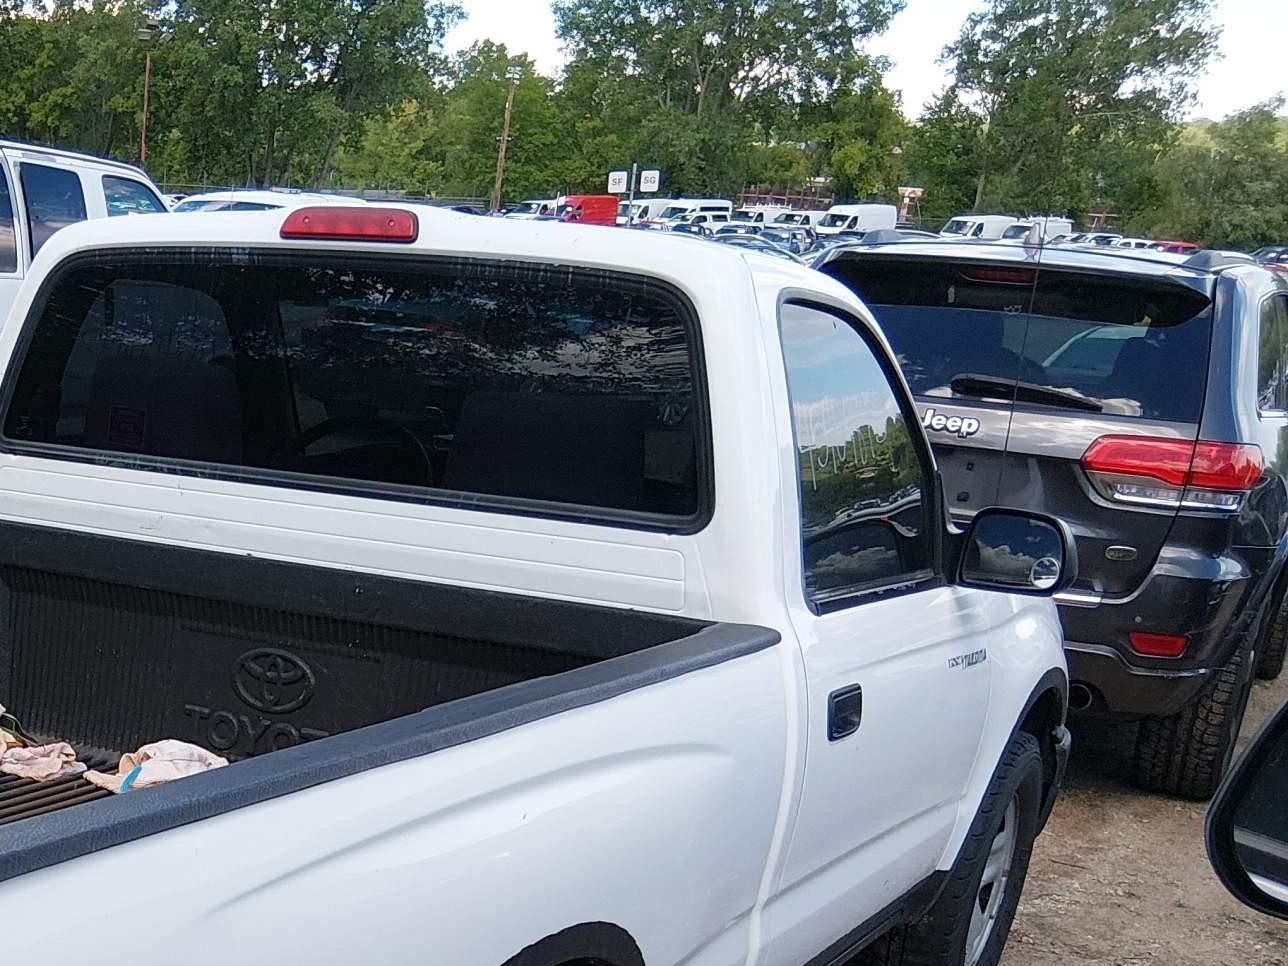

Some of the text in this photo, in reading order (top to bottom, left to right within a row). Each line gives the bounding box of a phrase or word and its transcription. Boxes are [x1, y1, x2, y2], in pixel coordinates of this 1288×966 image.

[611, 177, 623, 186] SF
[643, 176, 656, 184] SG
[920, 408, 981, 438] Jeep
[183, 703, 330, 757] TOYO
